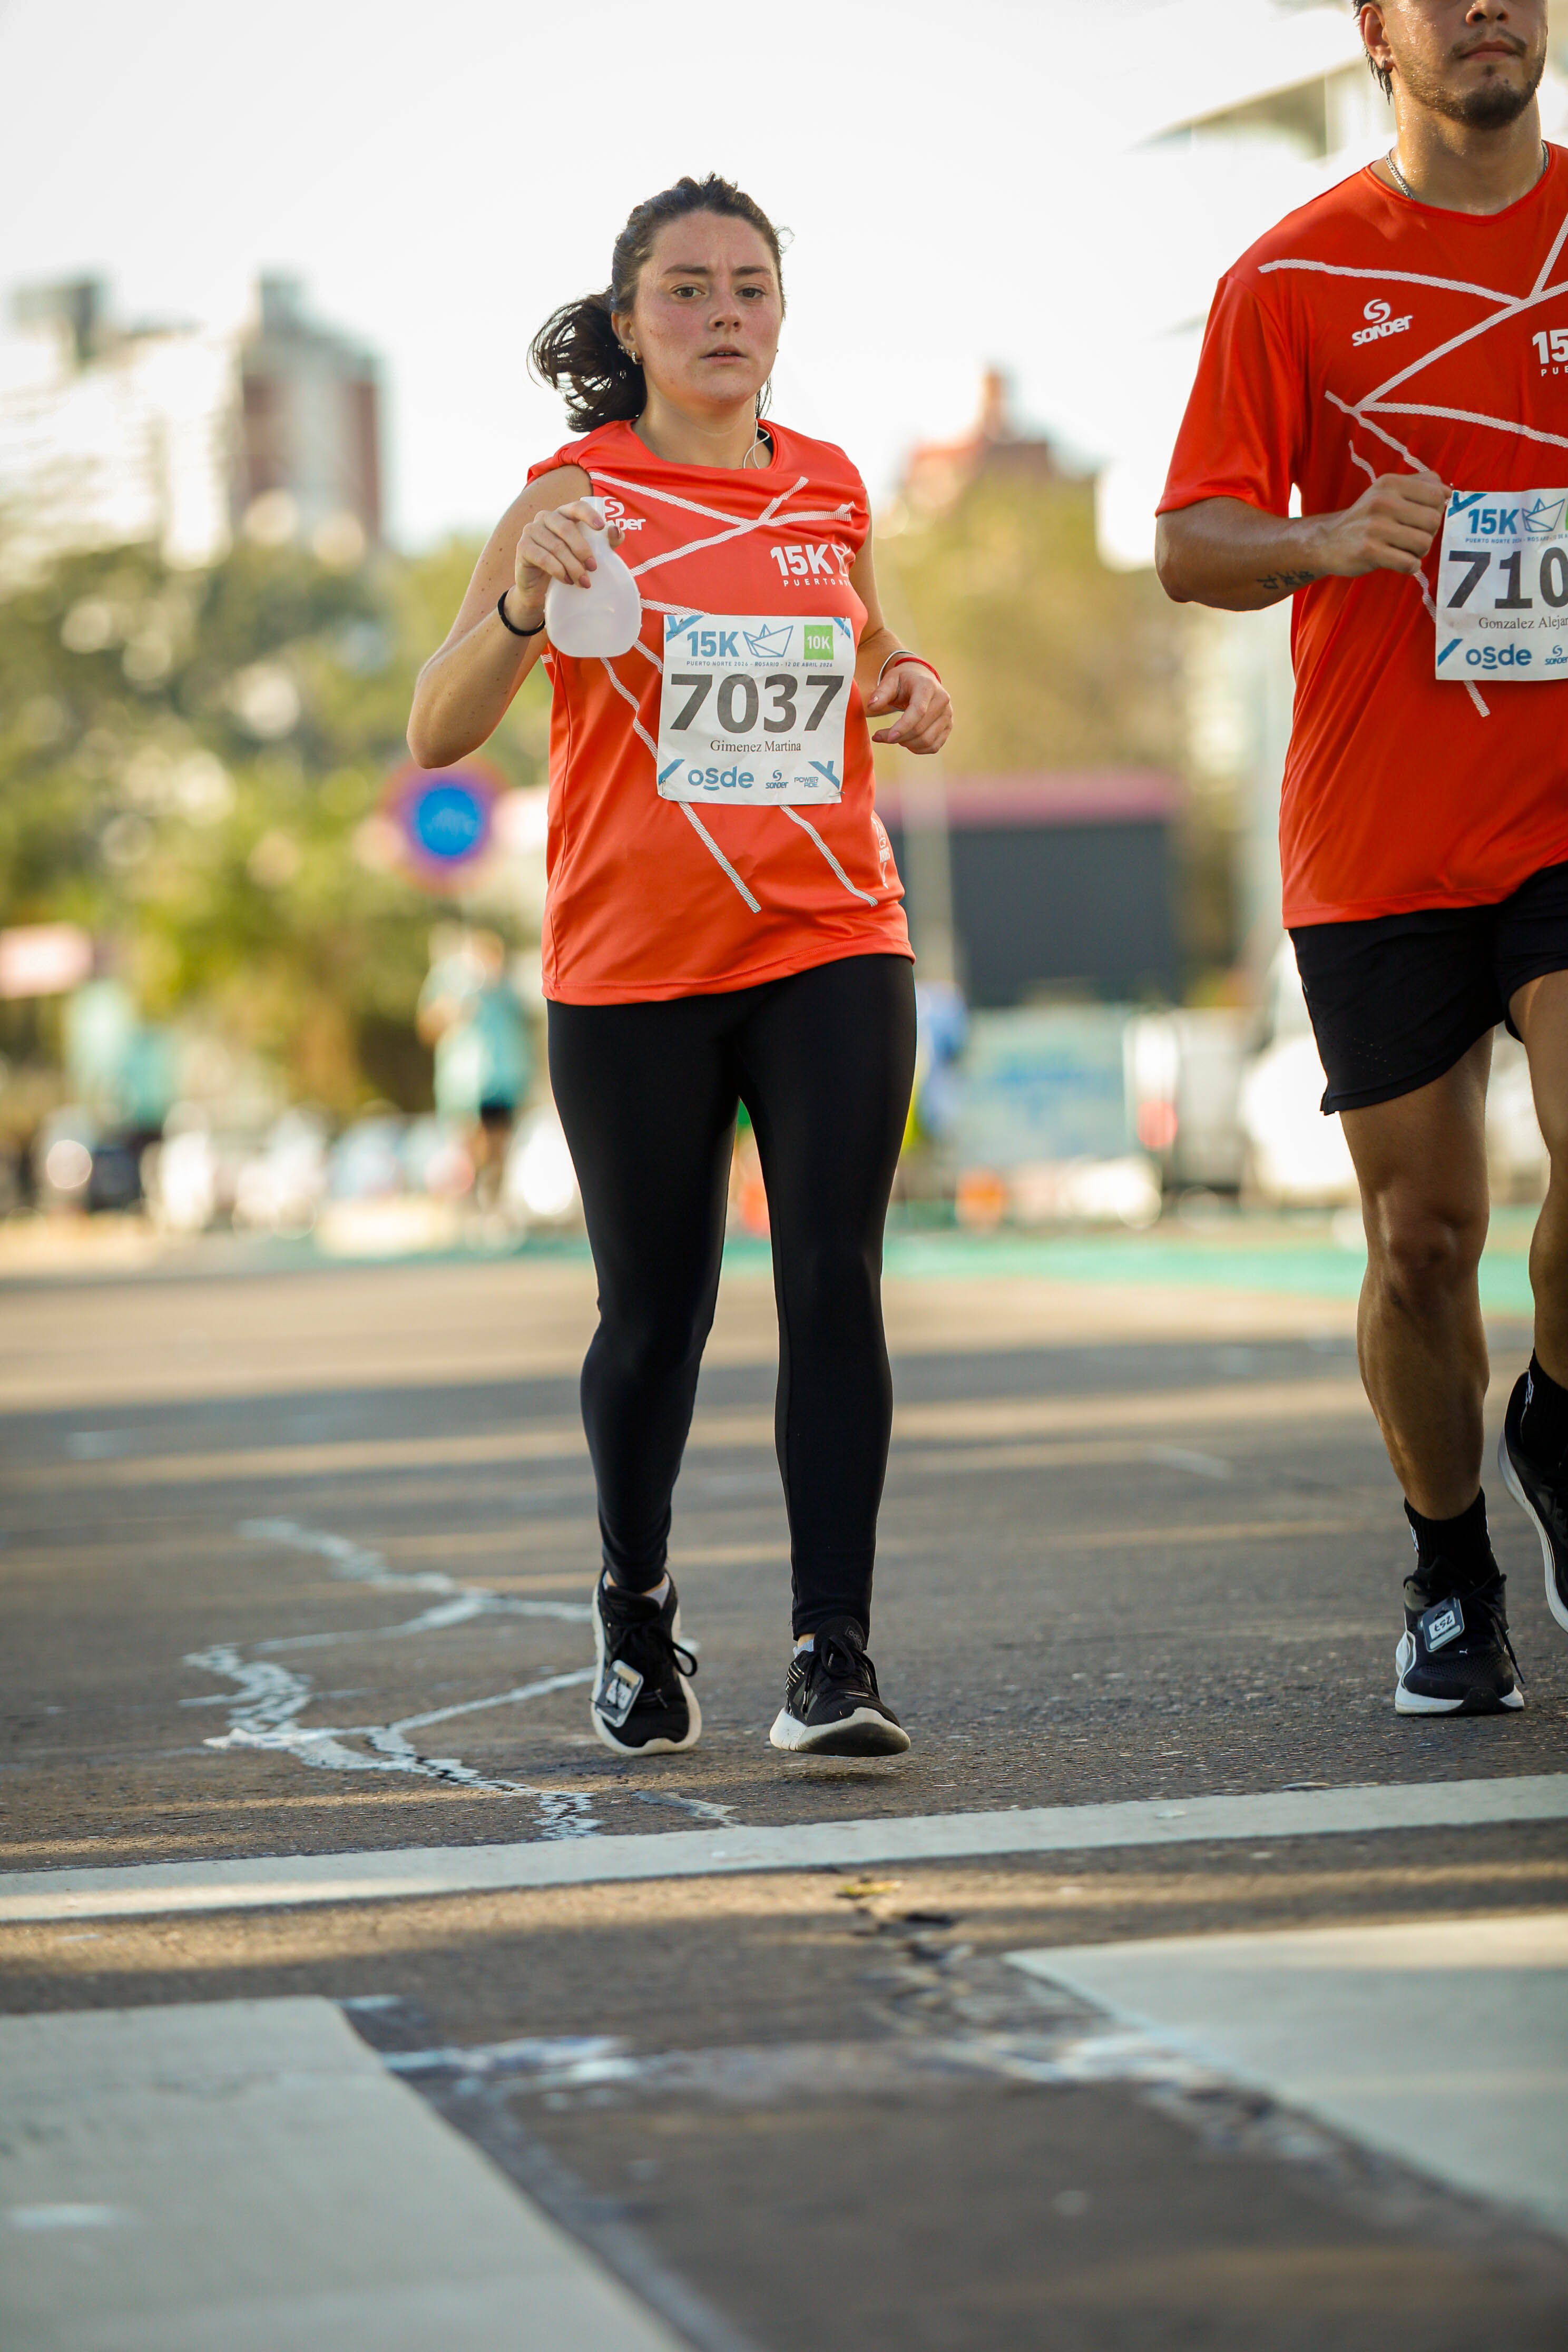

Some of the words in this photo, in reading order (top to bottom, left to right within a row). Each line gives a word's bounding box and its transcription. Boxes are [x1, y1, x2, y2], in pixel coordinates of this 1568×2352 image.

[1532, 329, 1568, 364] 15
[1541, 366, 1568, 377] PUE
[1468, 509, 1520, 534] 15K
[770, 544, 834, 576] 15K
[783, 578, 836, 587] PUERTO
[1447, 547, 1568, 608] 710
[1478, 617, 1535, 629] Gonzalez
[687, 631, 739, 657] 15K
[807, 635, 830, 650] 10K
[1466, 643, 1532, 670] osde
[670, 673, 844, 733] 7037
[710, 740, 762, 752] Gimenez
[765, 740, 801, 752] Martina
[688, 766, 754, 790] osde
